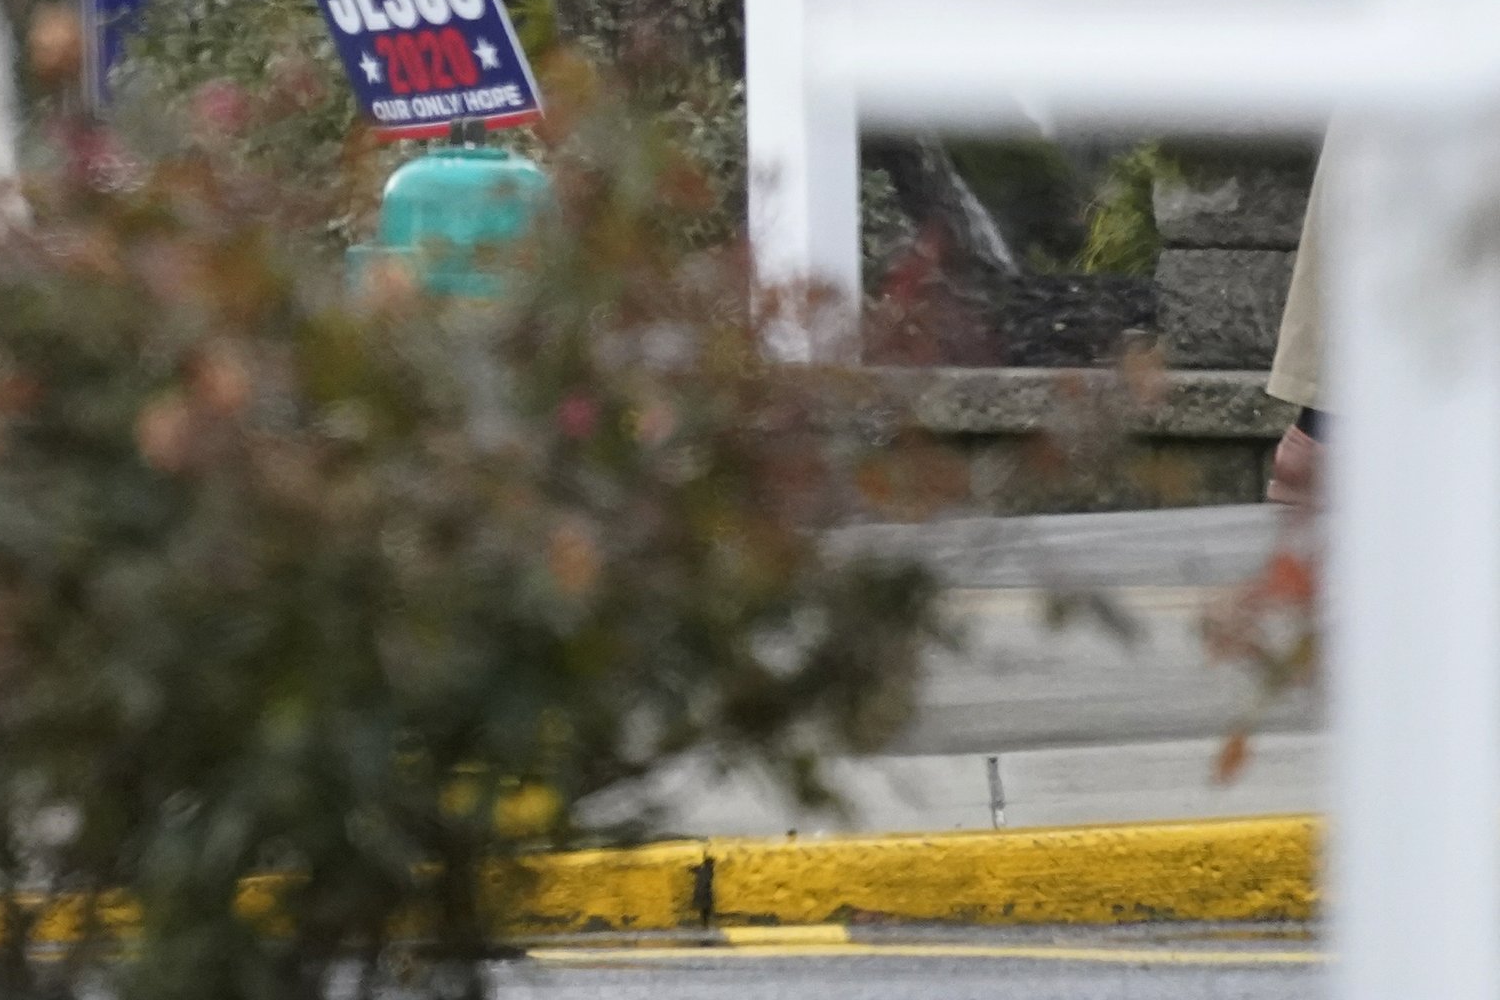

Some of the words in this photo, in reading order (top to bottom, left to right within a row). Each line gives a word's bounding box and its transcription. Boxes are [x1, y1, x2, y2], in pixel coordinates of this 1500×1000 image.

[376, 28, 478, 94] 2020
[373, 98, 410, 121] OUR
[412, 95, 460, 118] ONLY
[464, 85, 523, 110] HOPE
